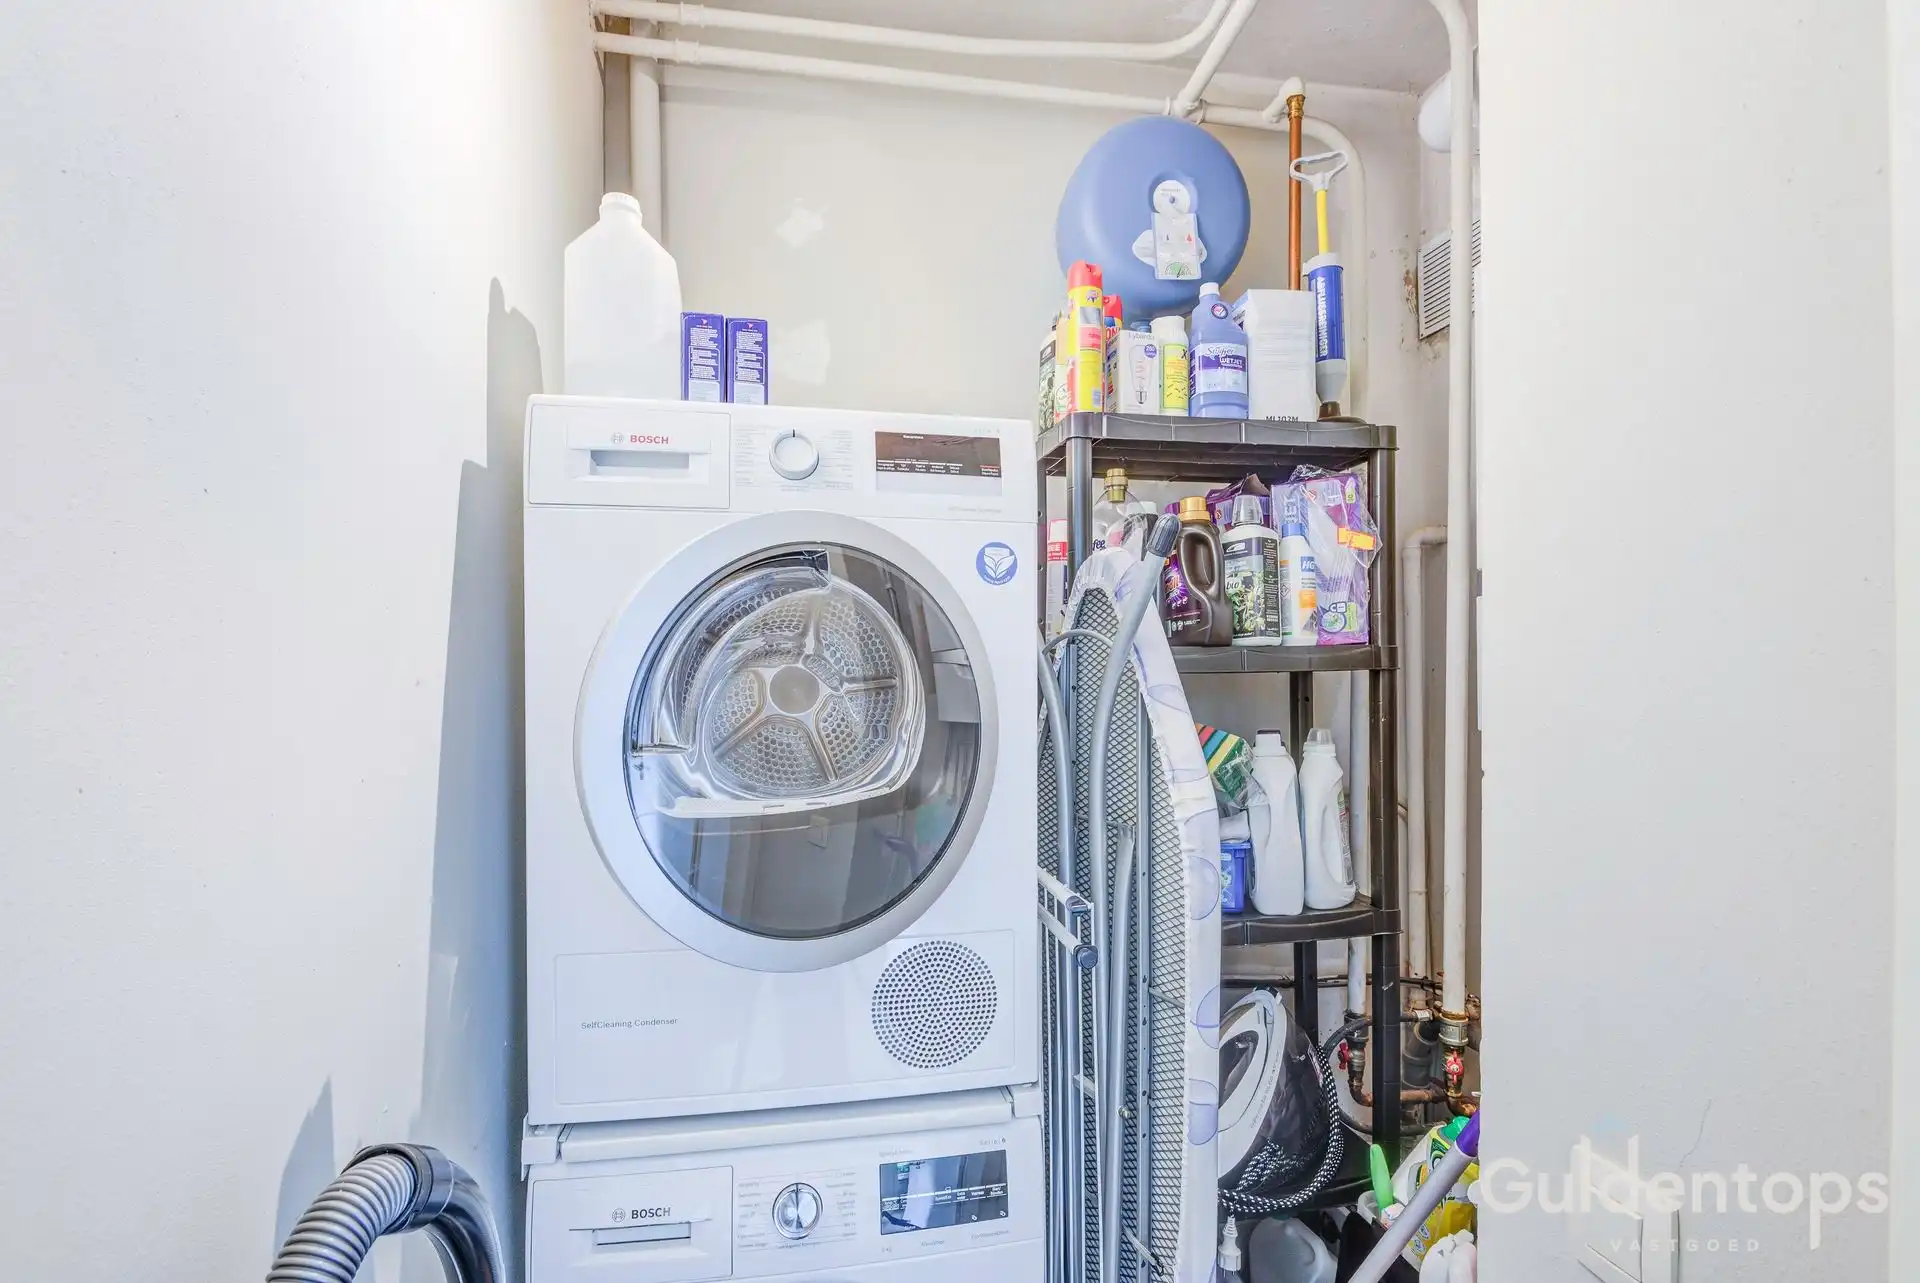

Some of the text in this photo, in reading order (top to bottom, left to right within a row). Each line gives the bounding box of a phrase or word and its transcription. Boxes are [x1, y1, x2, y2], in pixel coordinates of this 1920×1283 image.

[629, 434, 669, 445] BOSCH
[581, 1018, 678, 1030] SelfCleaning Condenser
[631, 1206, 671, 1219] BOSCH
